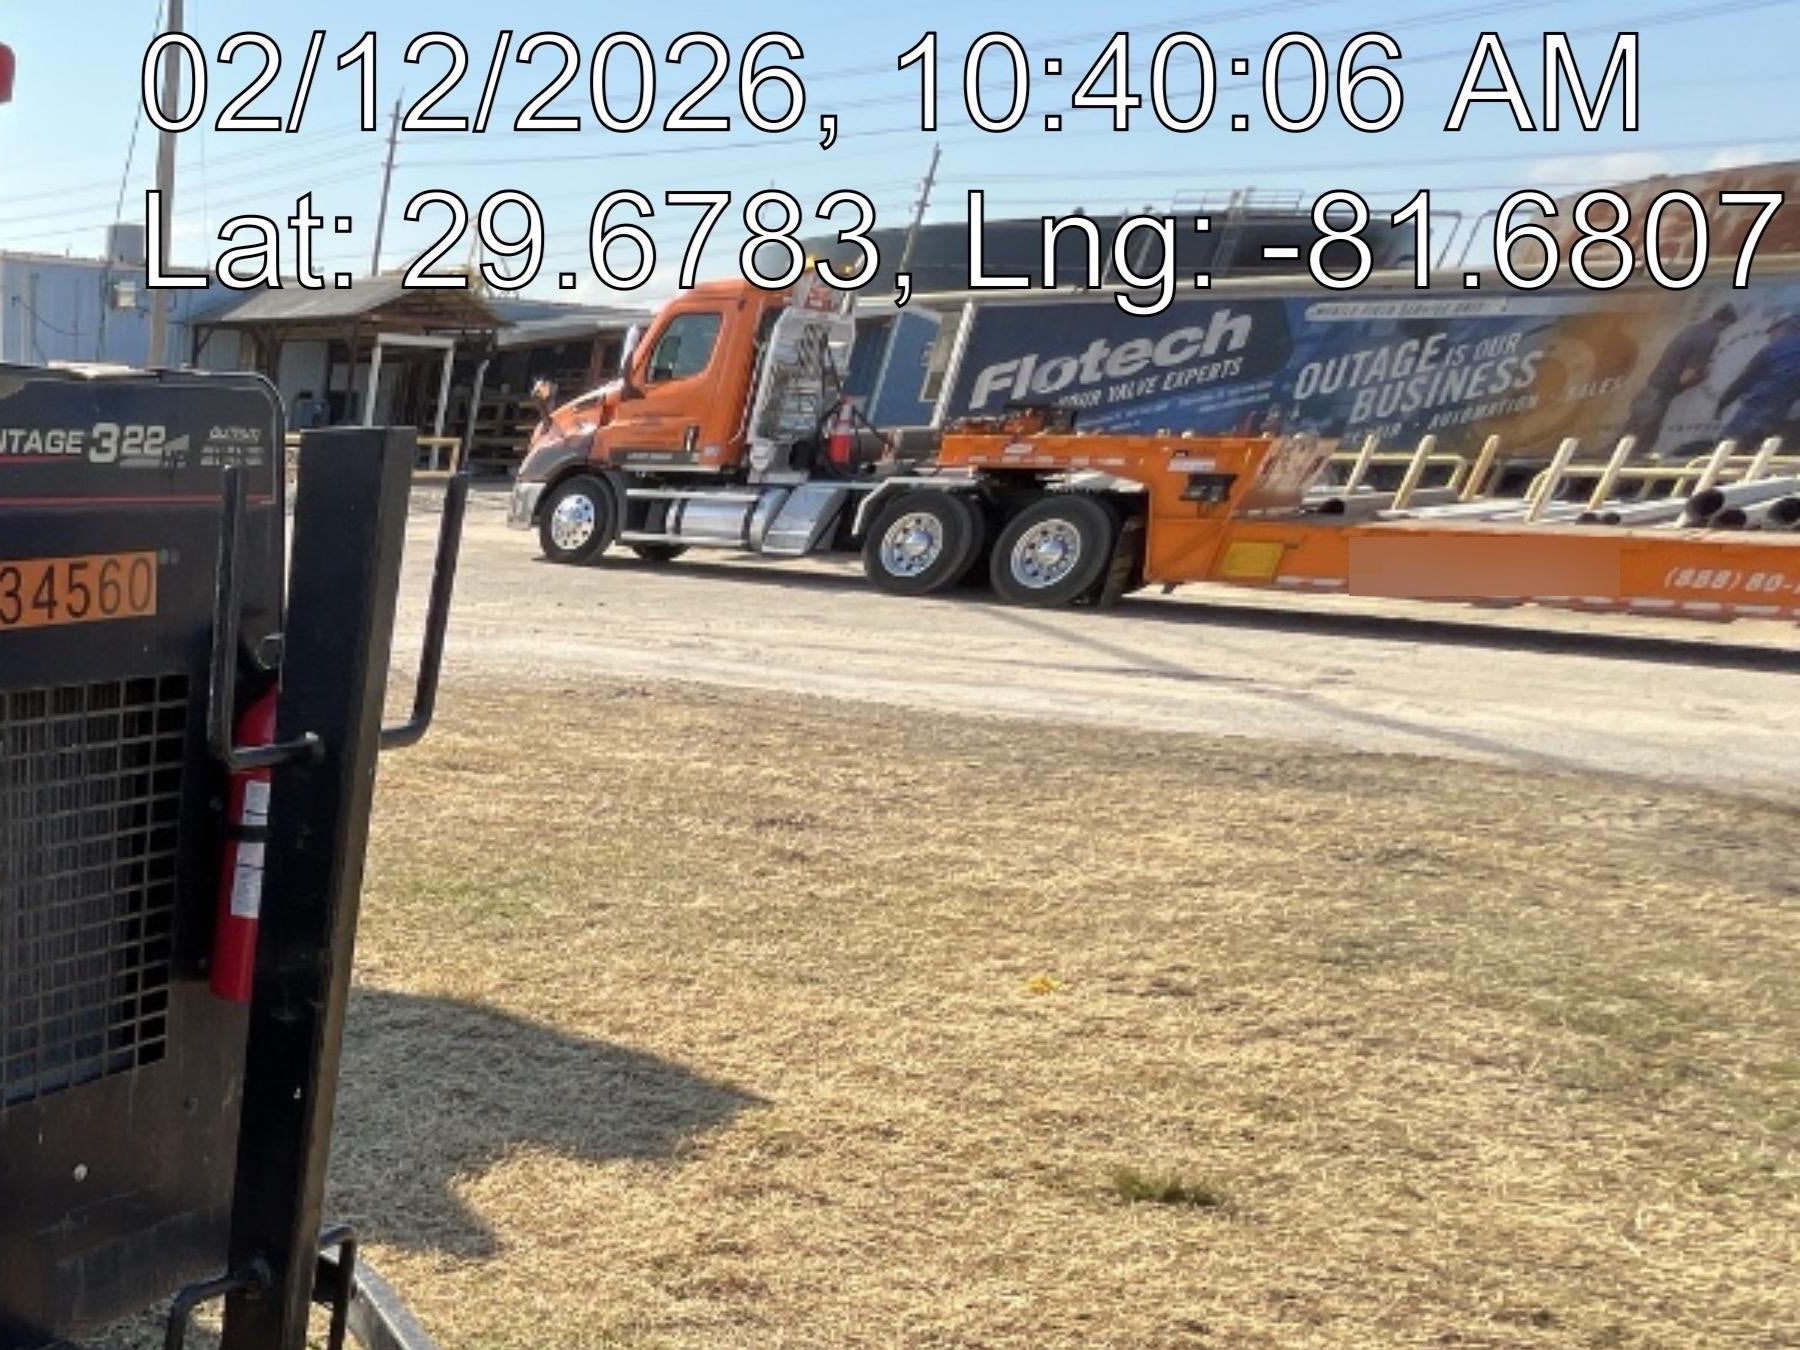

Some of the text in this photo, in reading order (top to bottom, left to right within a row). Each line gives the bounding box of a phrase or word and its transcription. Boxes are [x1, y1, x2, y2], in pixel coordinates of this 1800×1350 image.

[968, 308, 1253, 410] Flotech
[1162, 356, 1244, 392] EXPERTS
[1293, 333, 1448, 399] OUTAGE
[1444, 345, 1469, 367] IS
[1473, 333, 1522, 361] OUR
[1349, 351, 1544, 424] BUSINESS
[88, 421, 167, 464] 322
